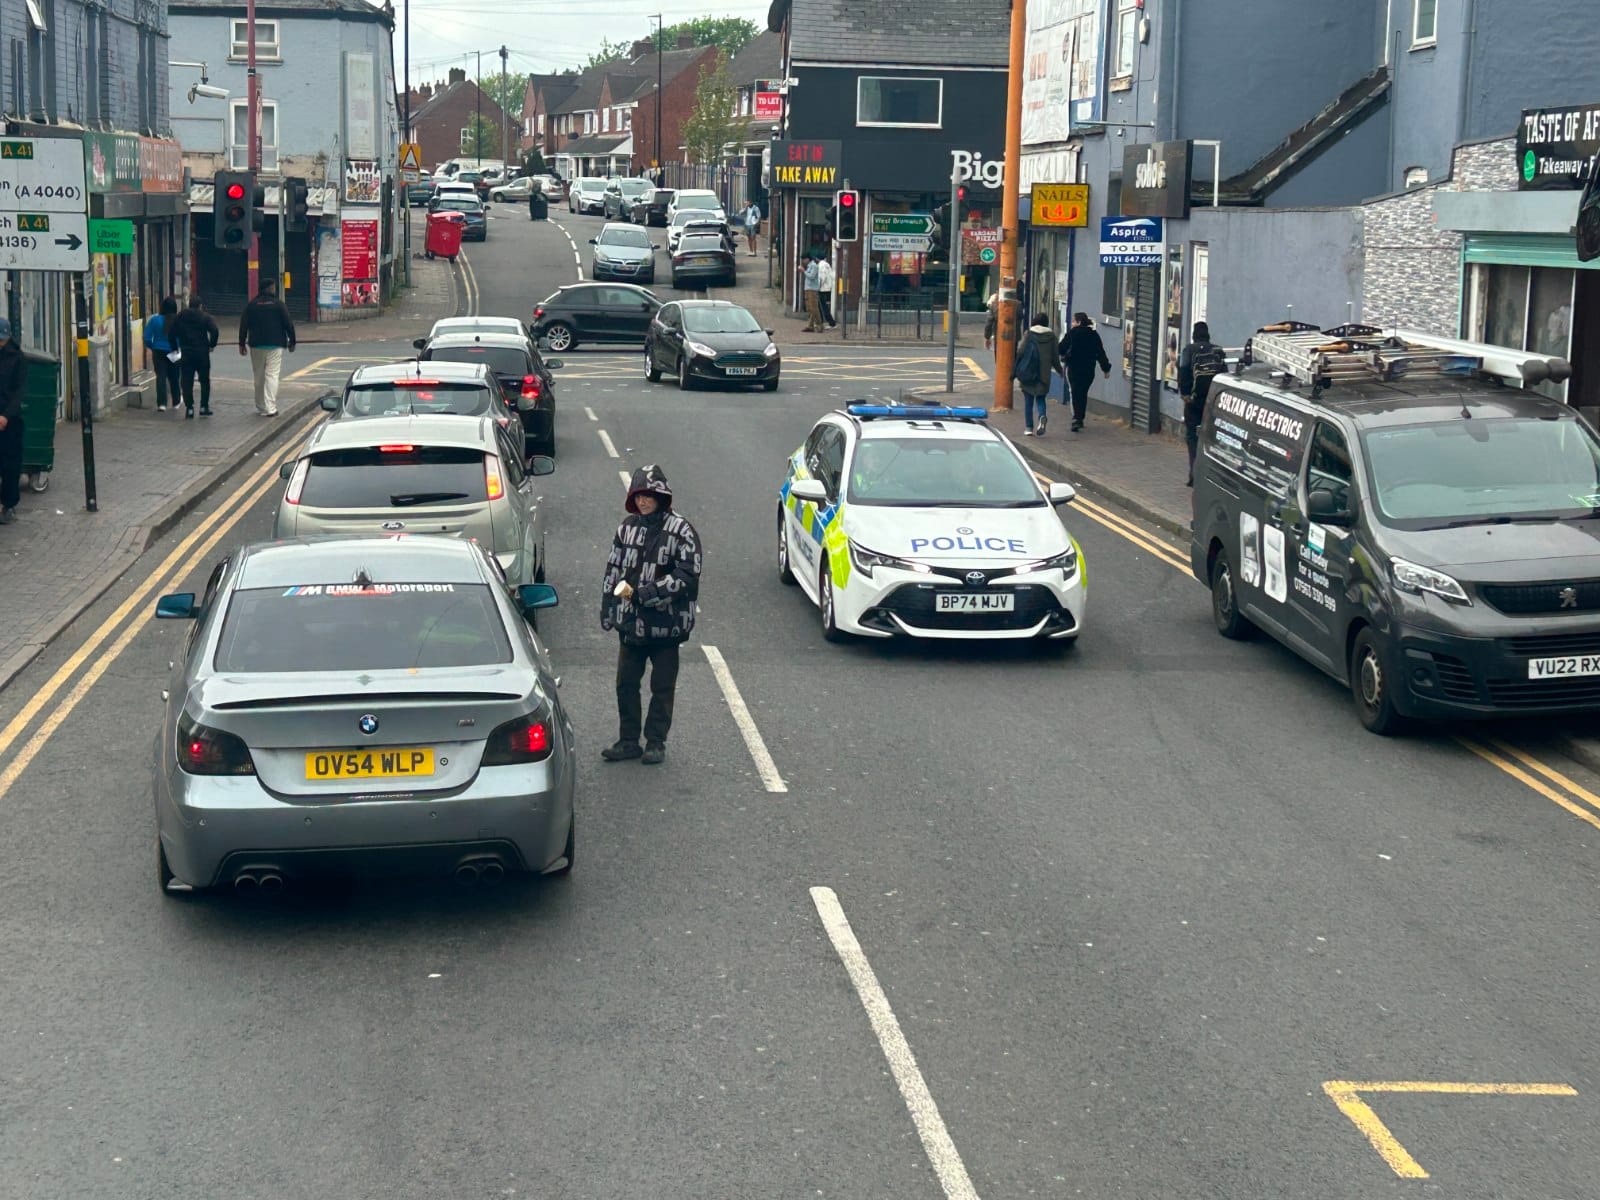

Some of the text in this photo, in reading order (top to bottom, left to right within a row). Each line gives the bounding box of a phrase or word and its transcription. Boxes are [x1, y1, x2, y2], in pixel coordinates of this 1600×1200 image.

[758, 97, 780, 105] TO LET
[1525, 112, 1562, 144] TASTE
[1564, 112, 1581, 142] OF
[3, 144, 32, 156] A 41
[788, 144, 824, 161] EAT IN
[775, 166, 836, 183] TAKE AWAY
[950, 150, 1005, 189] Big
[1539, 157, 1583, 178] Takeaway
[34, 186, 80, 200] 4040)
[1037, 190, 1084, 201] NAILS
[19, 217, 30, 228] A
[33, 217, 48, 228] 41
[1110, 227, 1147, 239] Aspire
[1110, 244, 1156, 252] TO LET
[1102, 255, 1122, 263] 0121
[1218, 391, 1303, 441] SULTAN OF ELECTRICS
[911, 536, 1027, 553] POLICE
[326, 584, 364, 595] BMW
[374, 583, 454, 594] Motorsport
[941, 595, 1008, 609] BP74 MJV
[1536, 657, 1600, 675] VU22 RX
[314, 751, 425, 776] OV54 WLP
